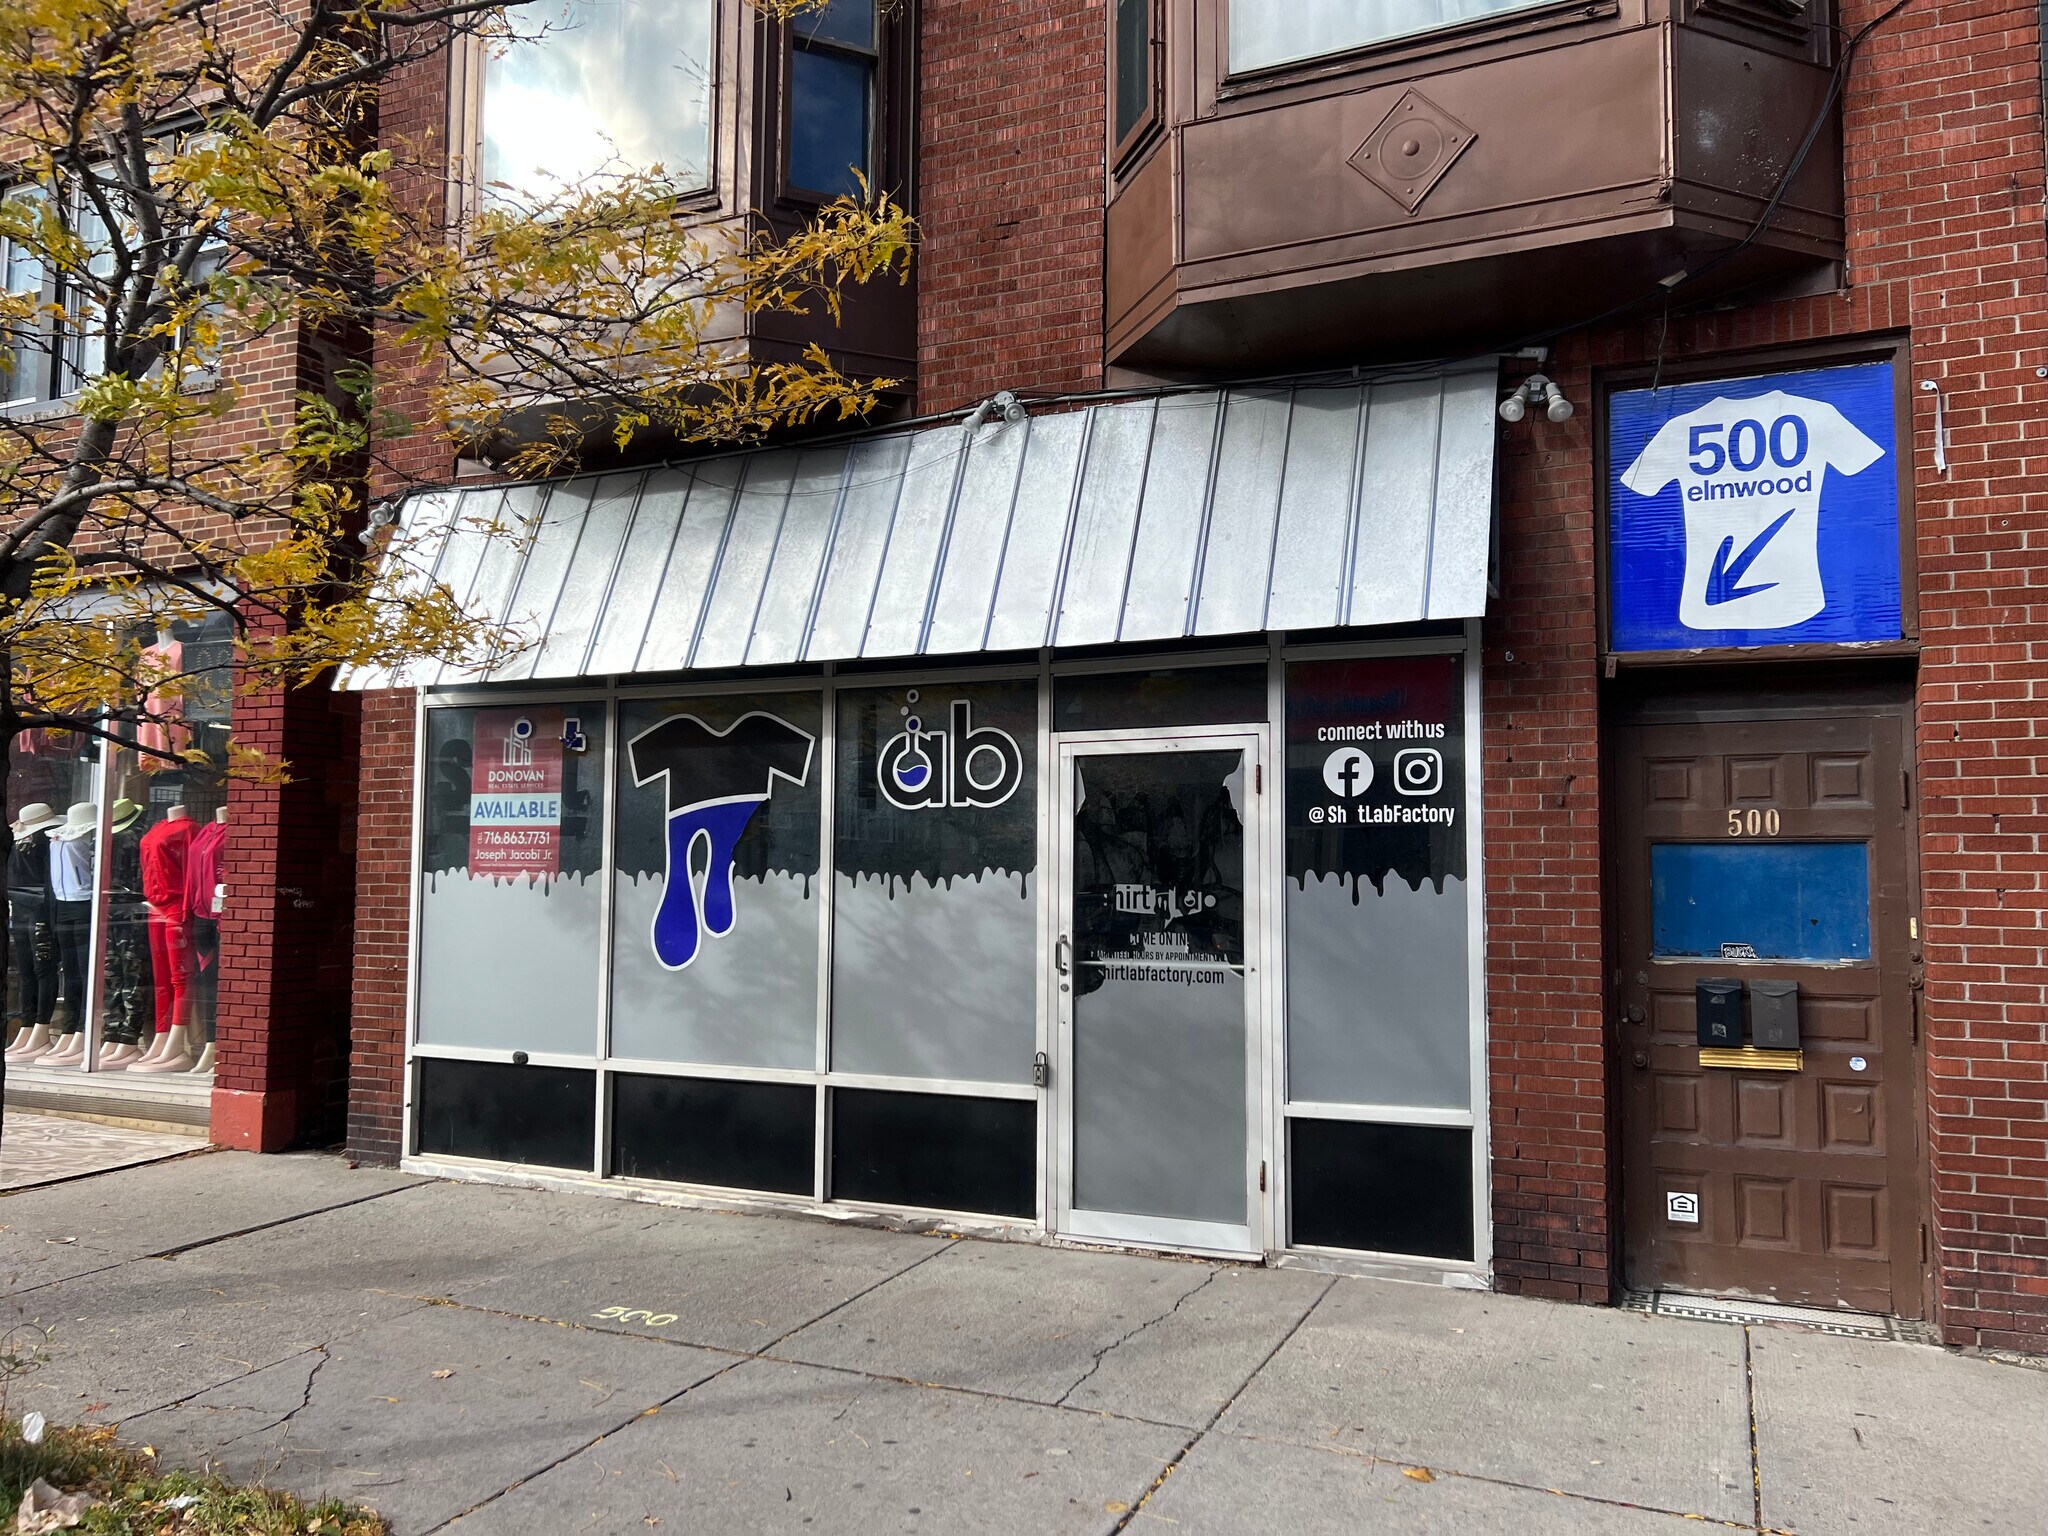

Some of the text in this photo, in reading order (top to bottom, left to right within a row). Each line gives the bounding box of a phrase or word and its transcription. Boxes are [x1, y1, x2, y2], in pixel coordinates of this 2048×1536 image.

[1688, 414, 1809, 476] 500
[1687, 470, 1813, 502] elmwood
[1317, 721, 1382, 741] connect
[488, 770, 545, 782] DONOVAN
[474, 800, 558, 819] AVAILABLE
[1728, 808, 1780, 837] 500
[484, 831, 550, 845] 716.863.7731
[475, 848, 553, 862] Joseph Jacobi Jr.
[1159, 931, 1173, 946] ON
[1156, 951, 1164, 960] BY
[589, 1306, 679, 1326] 500
